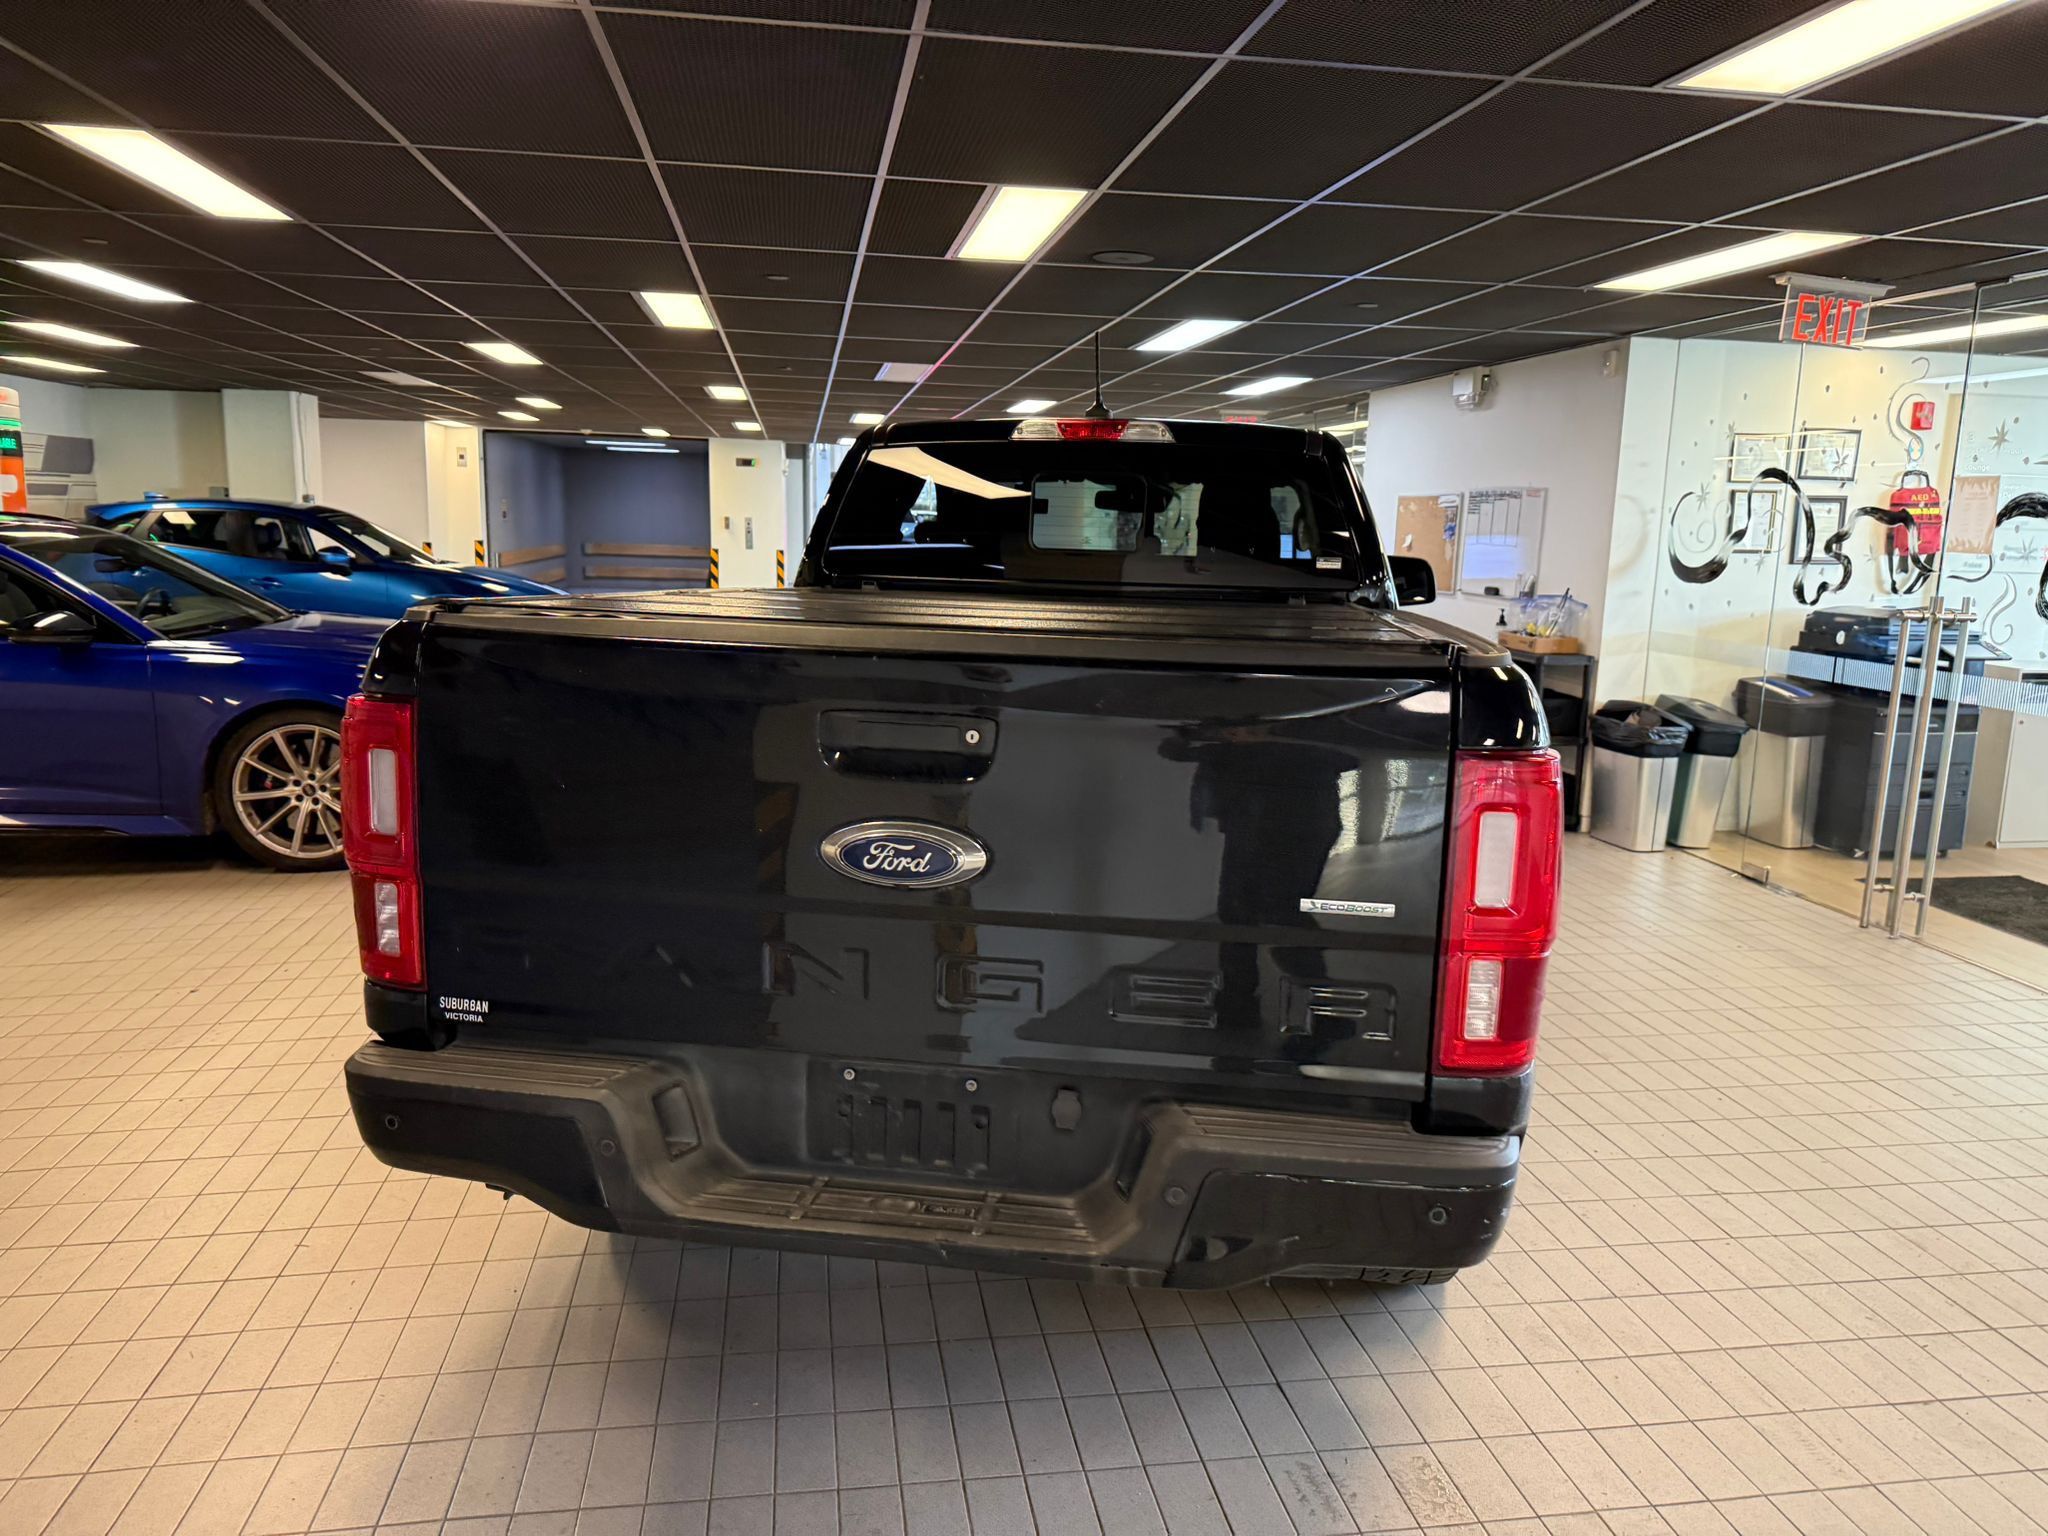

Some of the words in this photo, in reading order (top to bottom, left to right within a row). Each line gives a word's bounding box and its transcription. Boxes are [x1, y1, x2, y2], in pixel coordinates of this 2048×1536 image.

[1792, 293, 1863, 346] EXIT
[1910, 493, 1929, 501] AED
[863, 841, 932, 873] Ford
[440, 996, 489, 1013] SUBURBAN
[445, 1012, 484, 1023] VICTORIA
